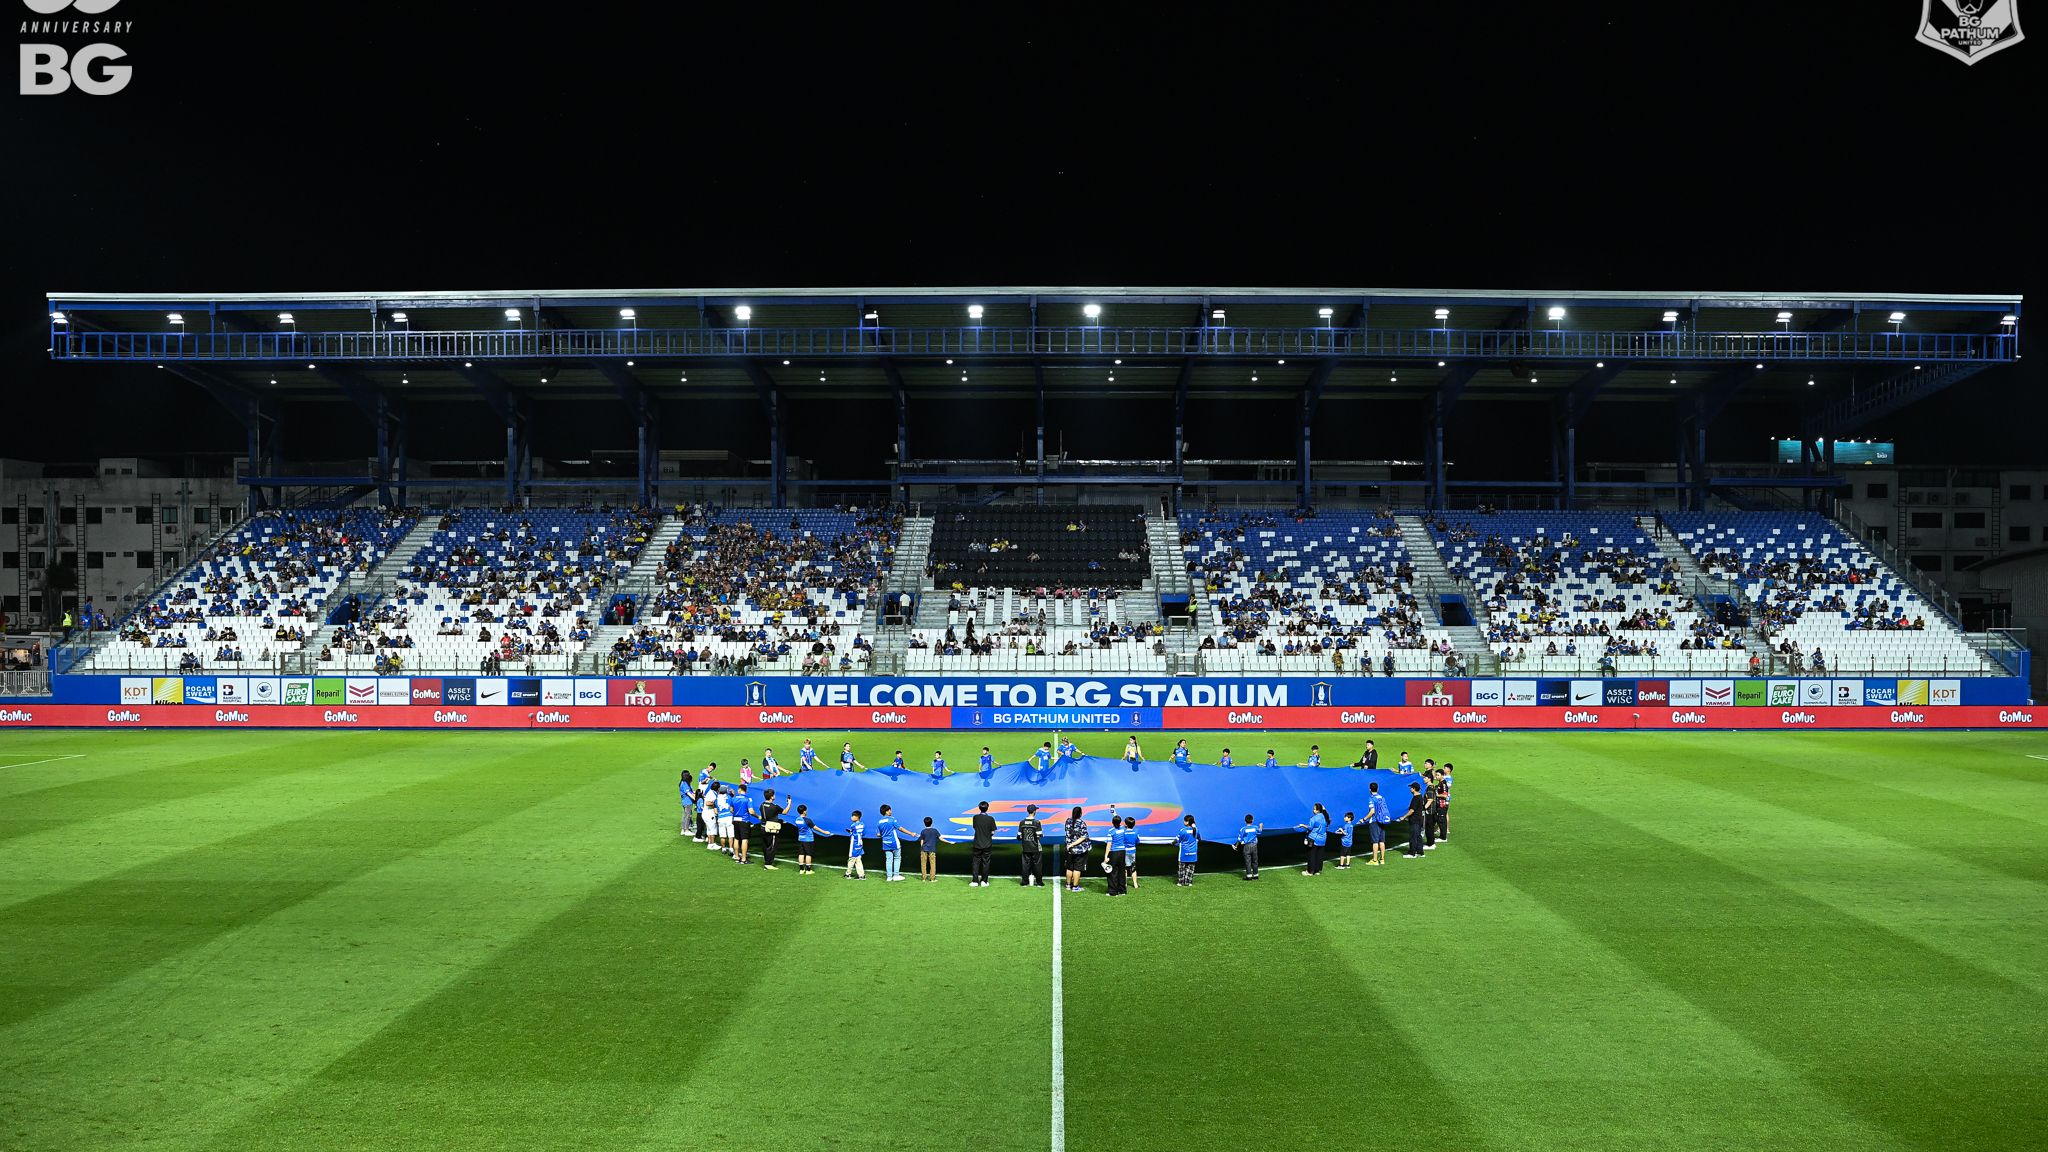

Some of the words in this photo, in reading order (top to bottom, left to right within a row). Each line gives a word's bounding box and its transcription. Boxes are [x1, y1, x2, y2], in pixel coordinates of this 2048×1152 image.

[124, 687, 148, 696] KDT
[286, 688, 308, 696] EURO
[790, 684, 978, 706] WELCOME
[985, 684, 1036, 706] TO
[1046, 681, 1111, 706] BG
[1119, 684, 1288, 706] STADIUM
[1476, 692, 1498, 700] BGC
[1933, 689, 1956, 698] KDT
[285, 695, 307, 703] CAKE
[1771, 696, 1792, 705] CAKE
[994, 714, 1012, 724] BG
[1014, 714, 1068, 724] PATHUM
[1072, 714, 1120, 724] UNITED
